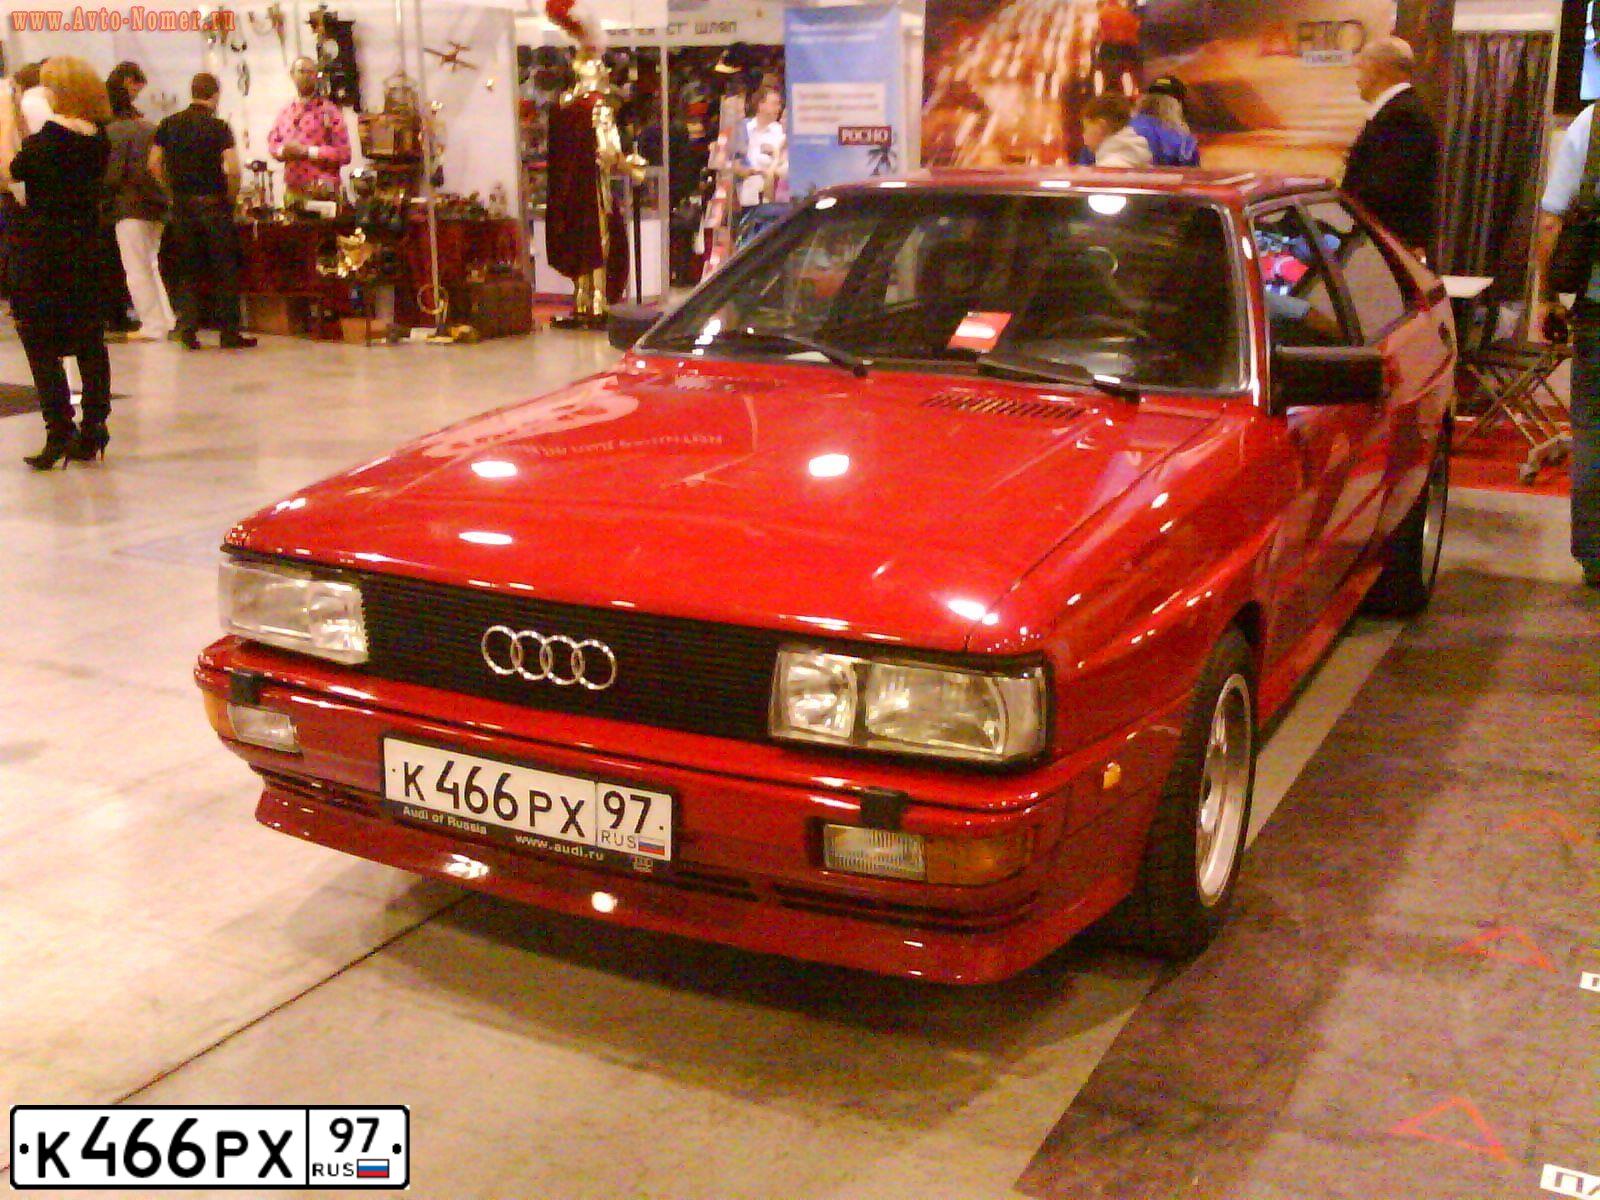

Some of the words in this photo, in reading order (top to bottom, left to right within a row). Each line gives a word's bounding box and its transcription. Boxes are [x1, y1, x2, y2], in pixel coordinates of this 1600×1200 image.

[403, 806, 429, 820] Audi
[432, 812, 445, 825] of
[447, 816, 488, 835] Russia
[603, 790, 652, 834] 97
[515, 834, 604, 861] www.audi.ru
[601, 829, 637, 849] RUS
